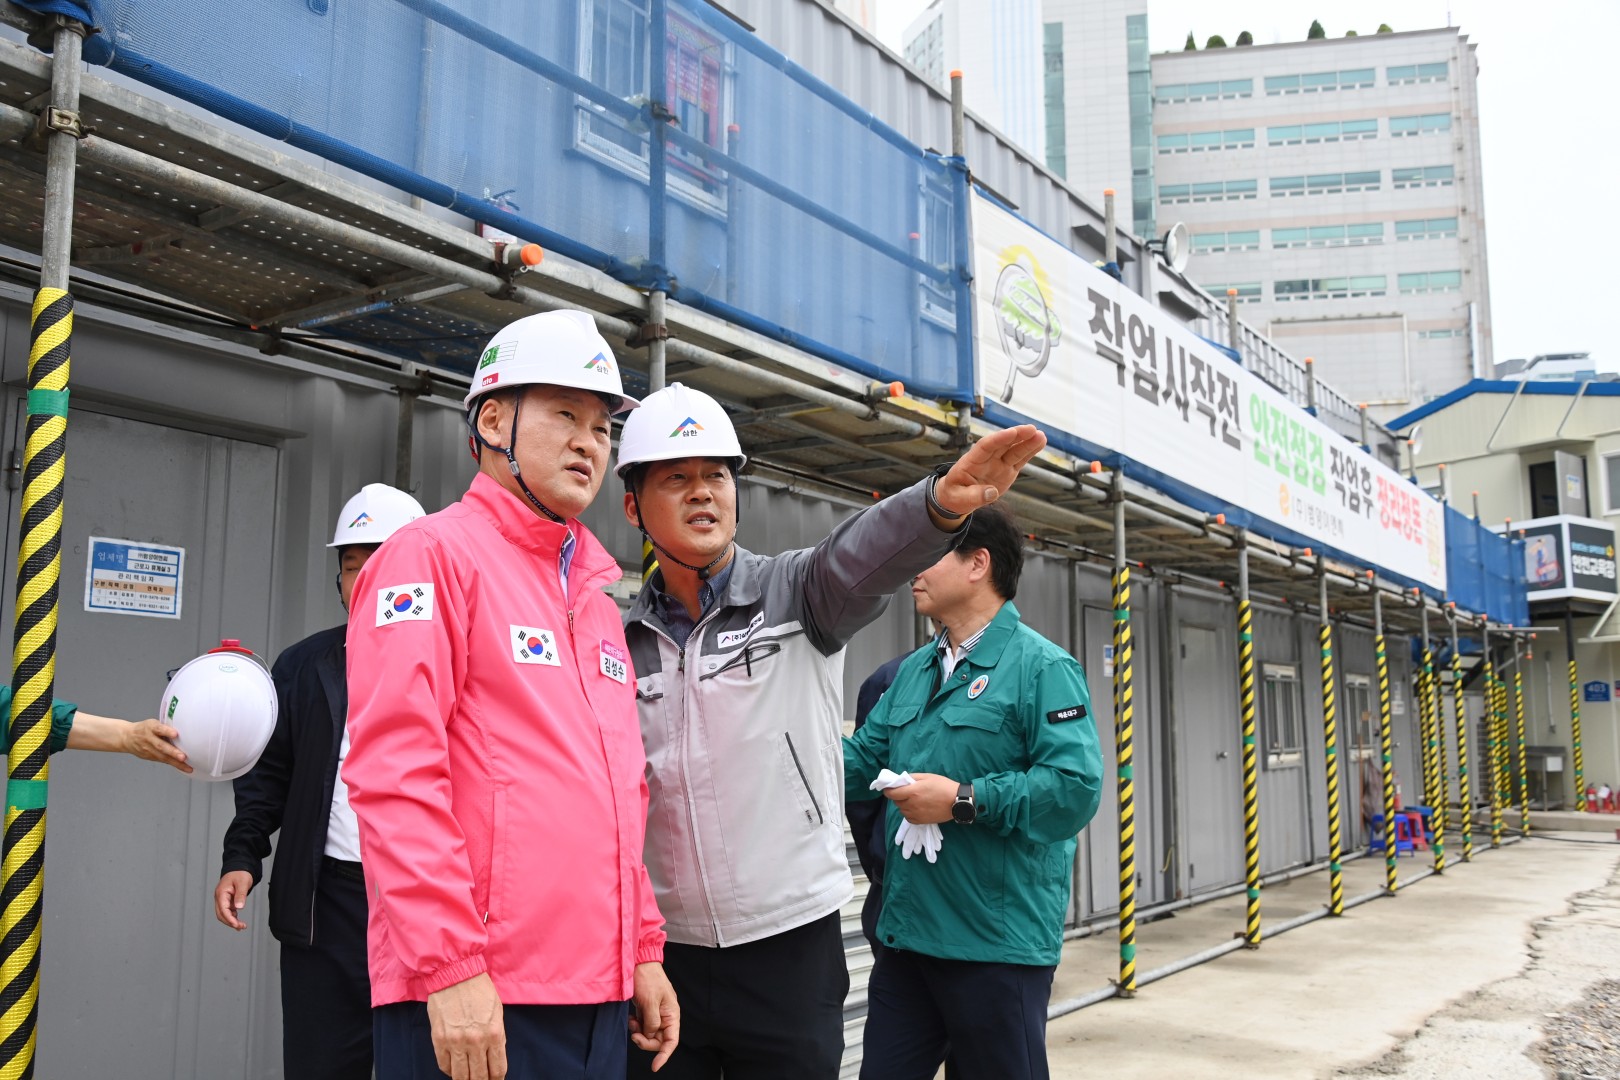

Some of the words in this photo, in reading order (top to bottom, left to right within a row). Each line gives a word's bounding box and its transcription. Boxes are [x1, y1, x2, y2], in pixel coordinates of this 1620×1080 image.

[596, 365, 609, 375] 삼한
[1087, 287, 1242, 451] 작업시작전
[1250, 393, 1326, 496] 안전점검
[1329, 445, 1374, 519] 작업후
[1376, 475, 1423, 545] 정리정돈
[682, 429, 698, 437] 삼한
[604, 657, 625, 680] 김성수
